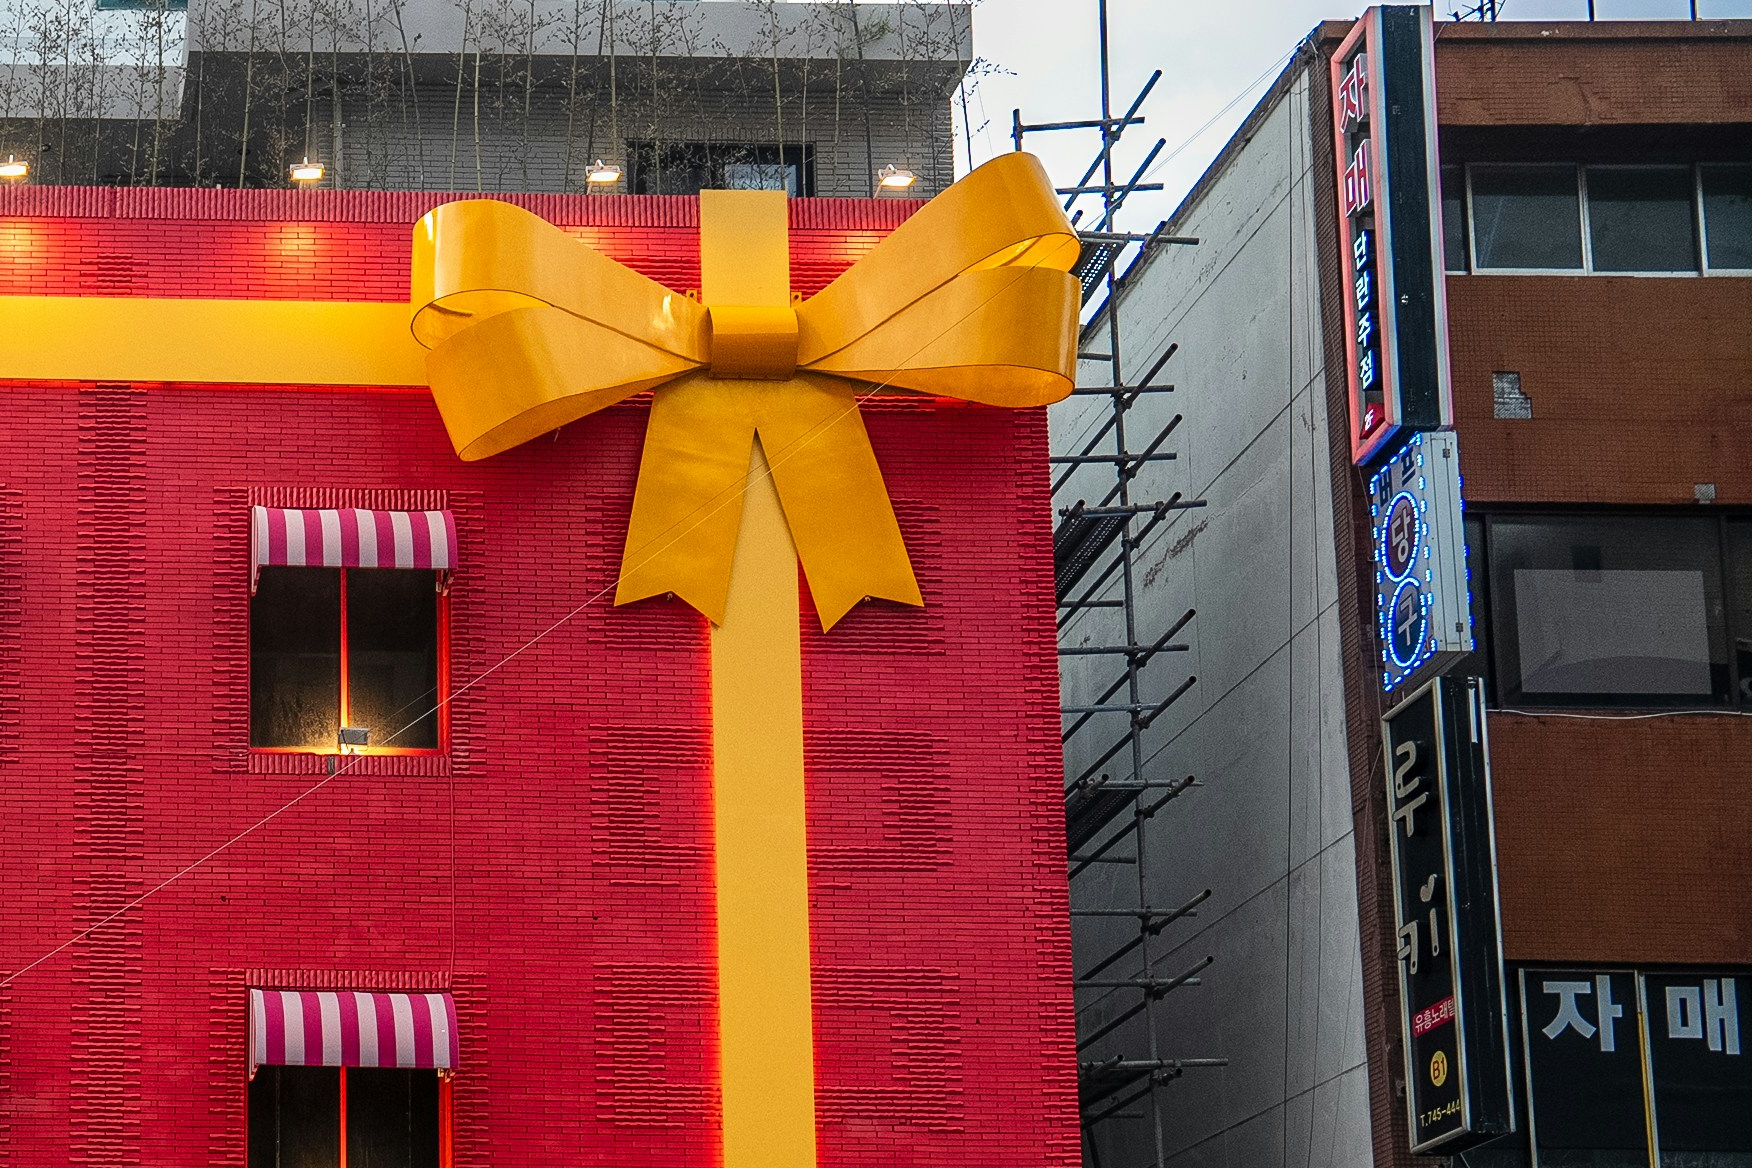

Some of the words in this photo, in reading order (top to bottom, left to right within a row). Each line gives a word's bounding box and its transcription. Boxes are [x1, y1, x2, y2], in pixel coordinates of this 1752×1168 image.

[1339, 53, 1370, 218] 자매
[1353, 229, 1376, 391] 단란주점
[1390, 506, 1418, 646] 당구
[1392, 740, 1440, 975] 루키
[1432, 1056, 1446, 1081] B1
[1542, 974, 1741, 1055] 자매
